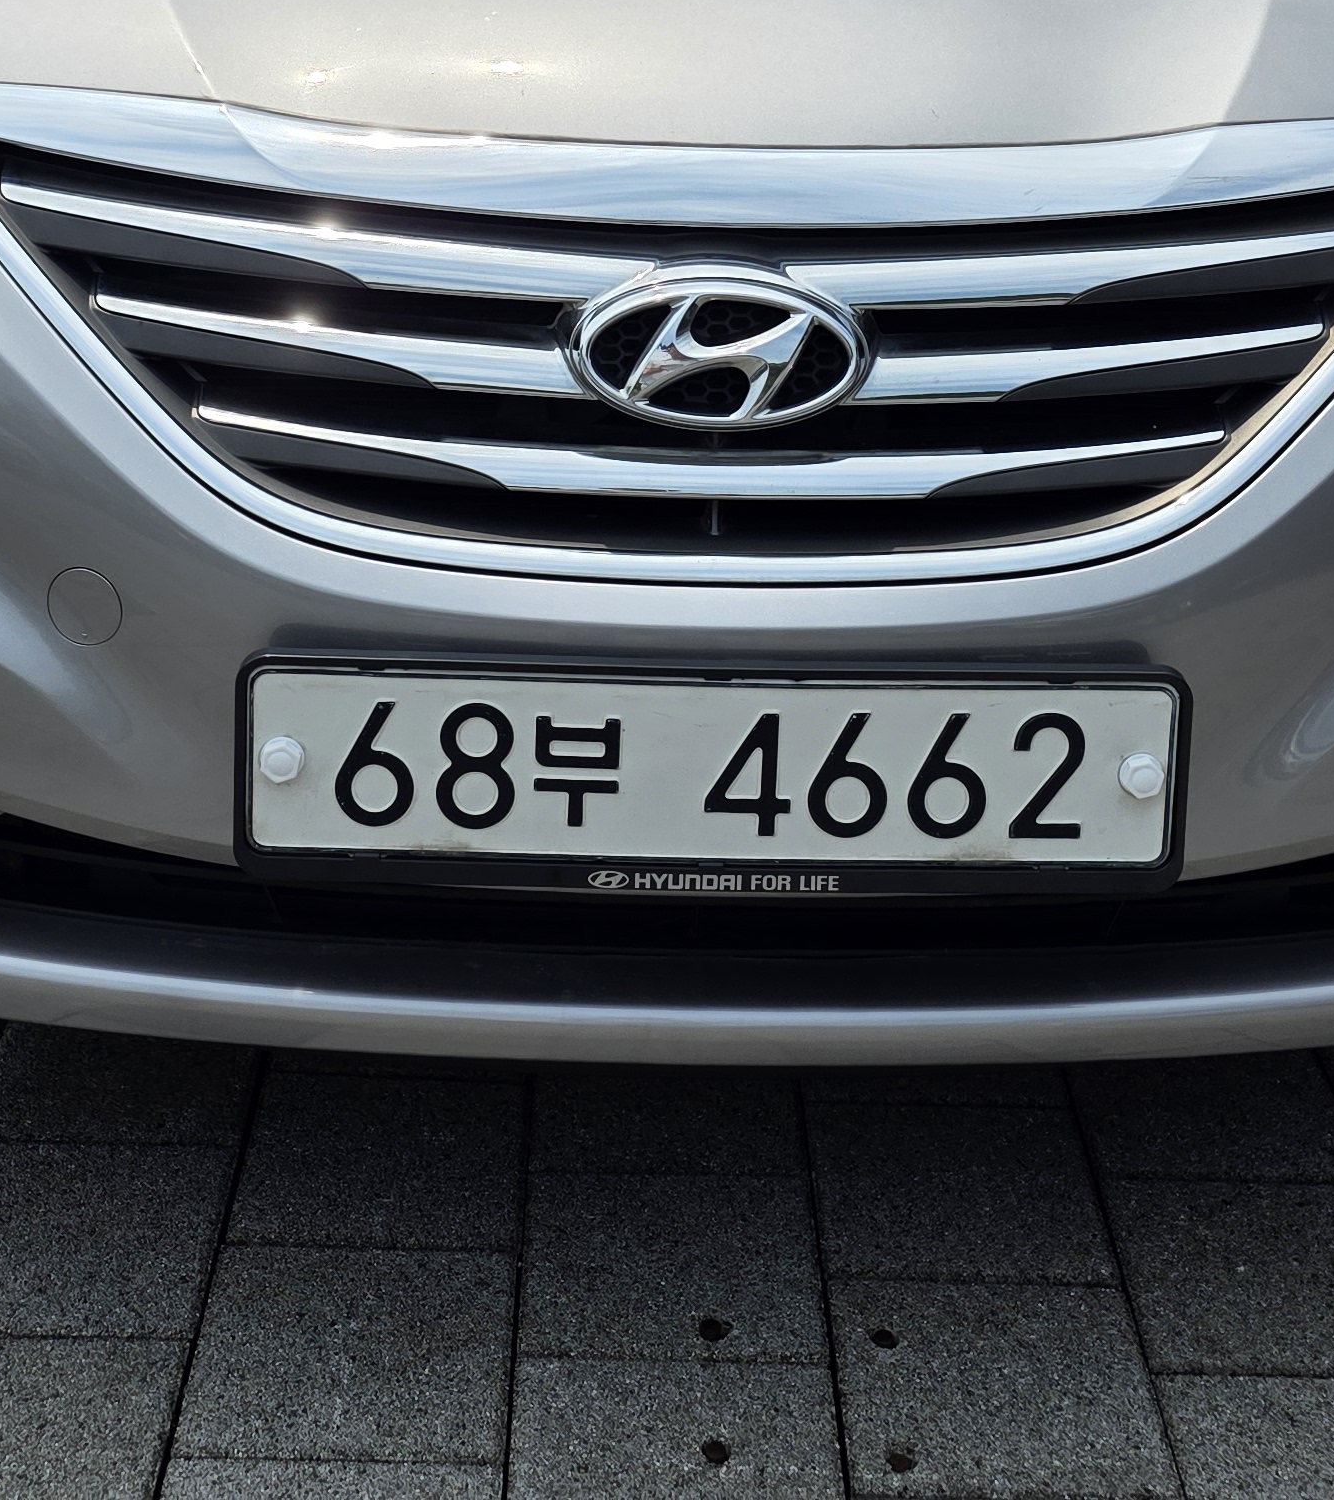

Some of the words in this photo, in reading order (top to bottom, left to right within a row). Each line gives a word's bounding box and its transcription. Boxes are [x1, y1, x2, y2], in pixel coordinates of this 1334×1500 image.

[334, 699, 622, 830] 68부
[703, 711, 1087, 840] 4662
[634, 872, 742, 891] HYUNDAI
[750, 874, 791, 891] FOR
[799, 875, 840, 891] LIFE
